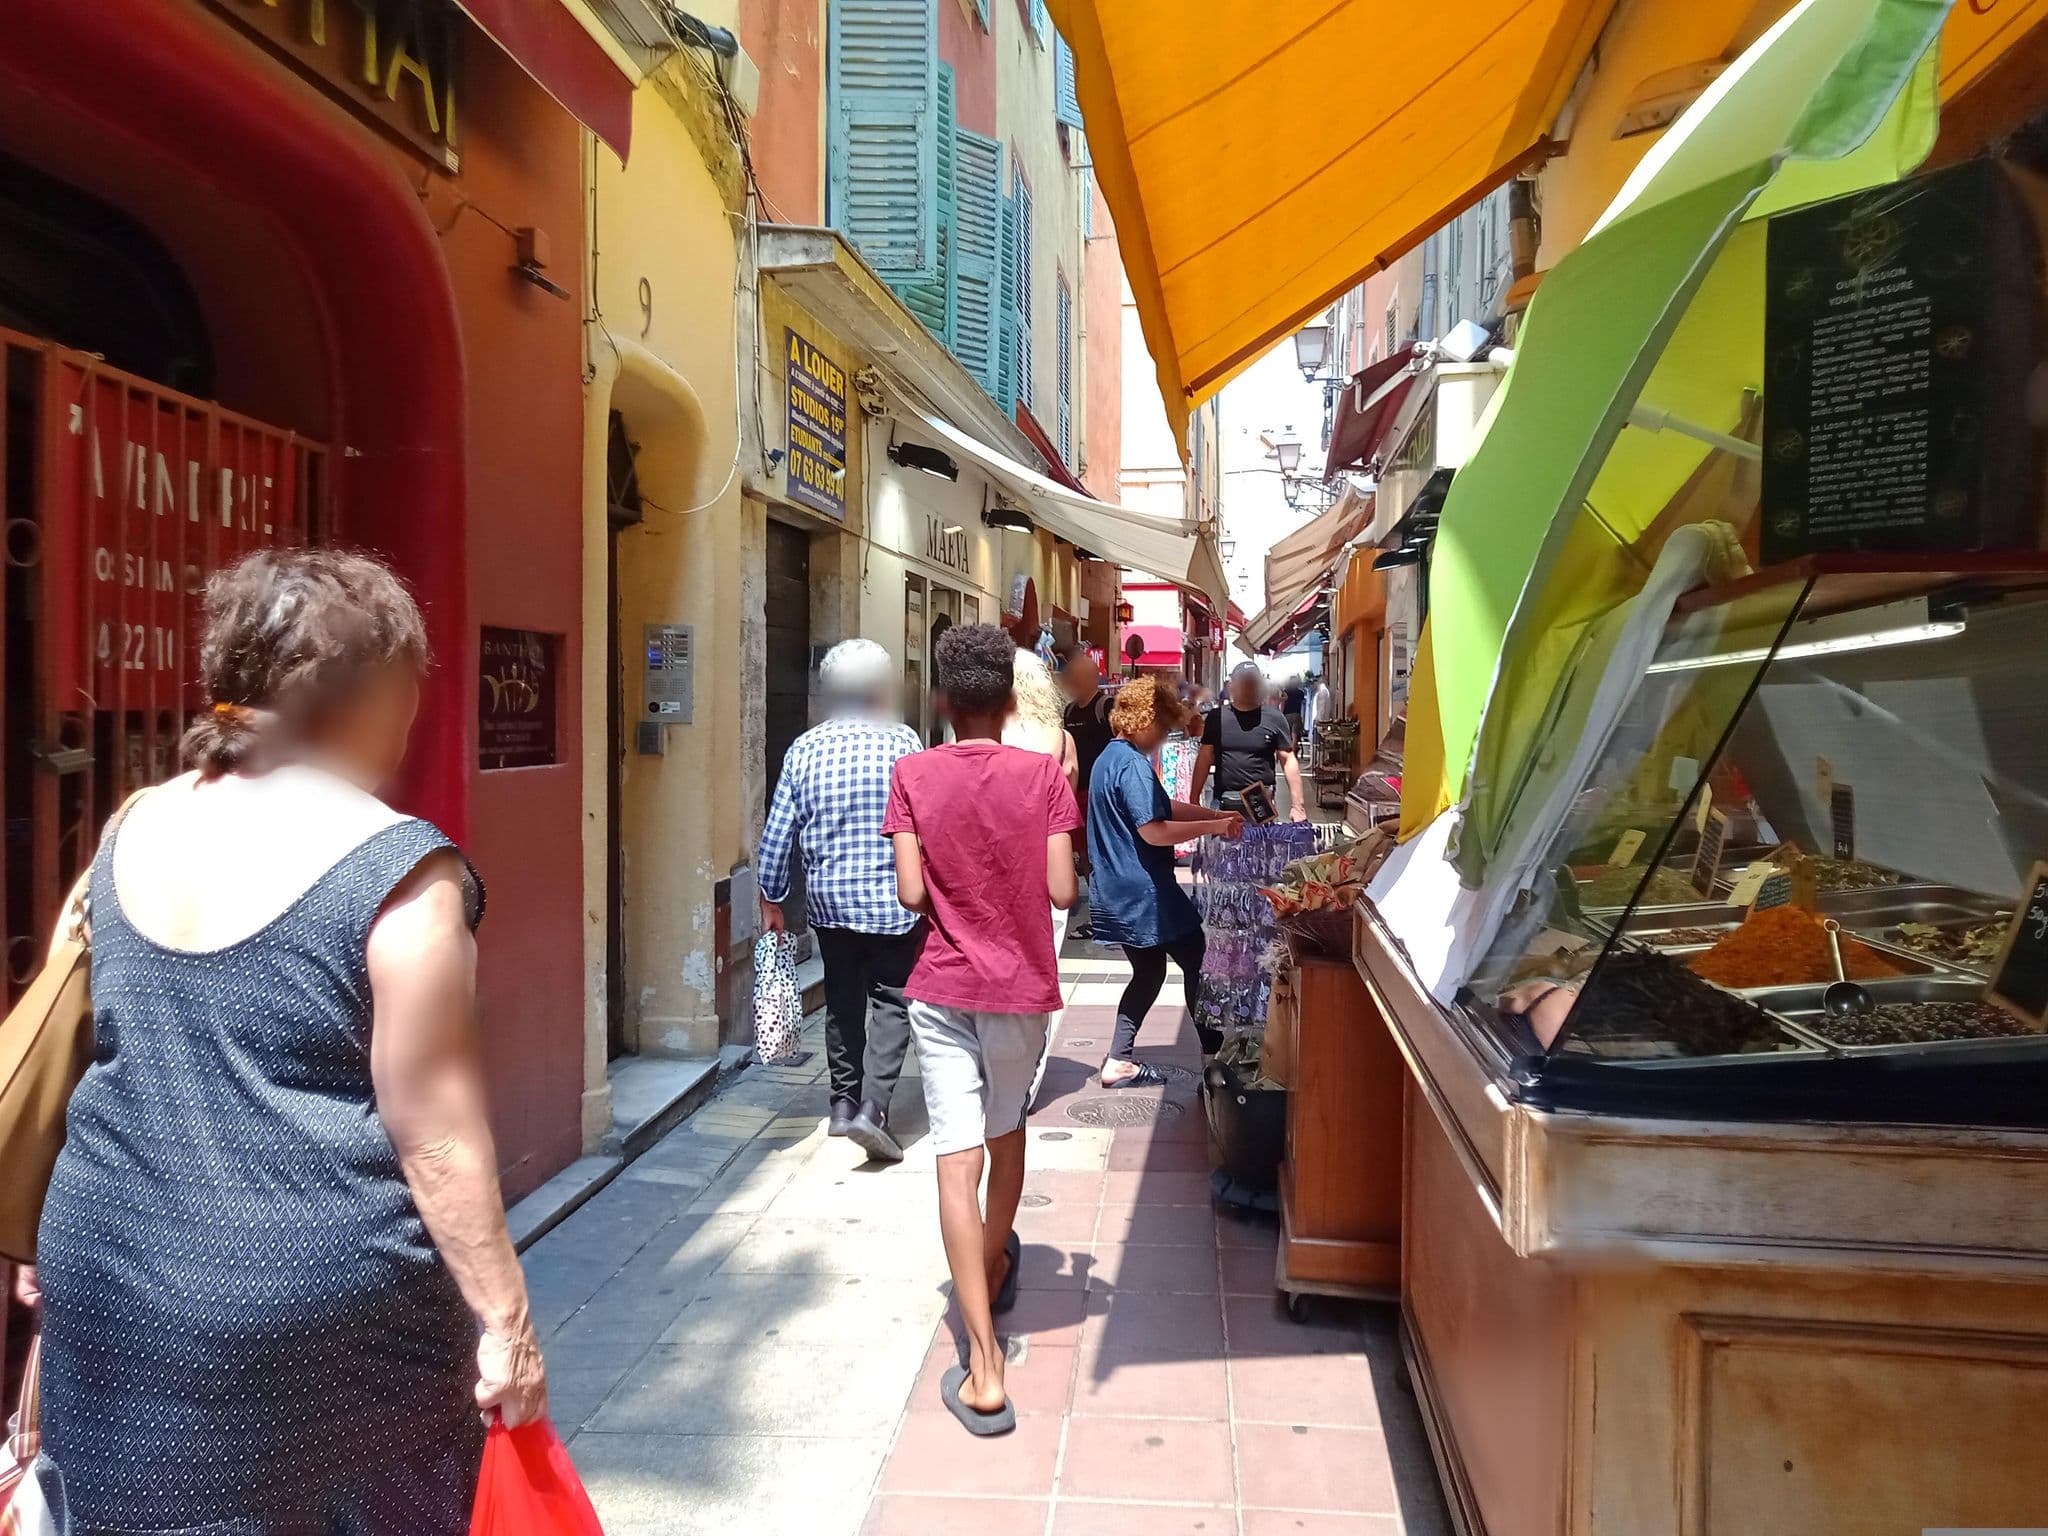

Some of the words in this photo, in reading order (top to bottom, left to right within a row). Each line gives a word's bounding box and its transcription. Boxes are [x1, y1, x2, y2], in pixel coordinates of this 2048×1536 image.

[638, 276, 652, 339] 9
[790, 335, 800, 367] A
[803, 343, 844, 399] LOUER
[790, 384, 830, 428] STUDIOS
[790, 423, 823, 458] ETUDIANTS
[789, 448, 802, 478] 07
[803, 455, 814, 486] 63
[815, 461, 825, 491] 63
